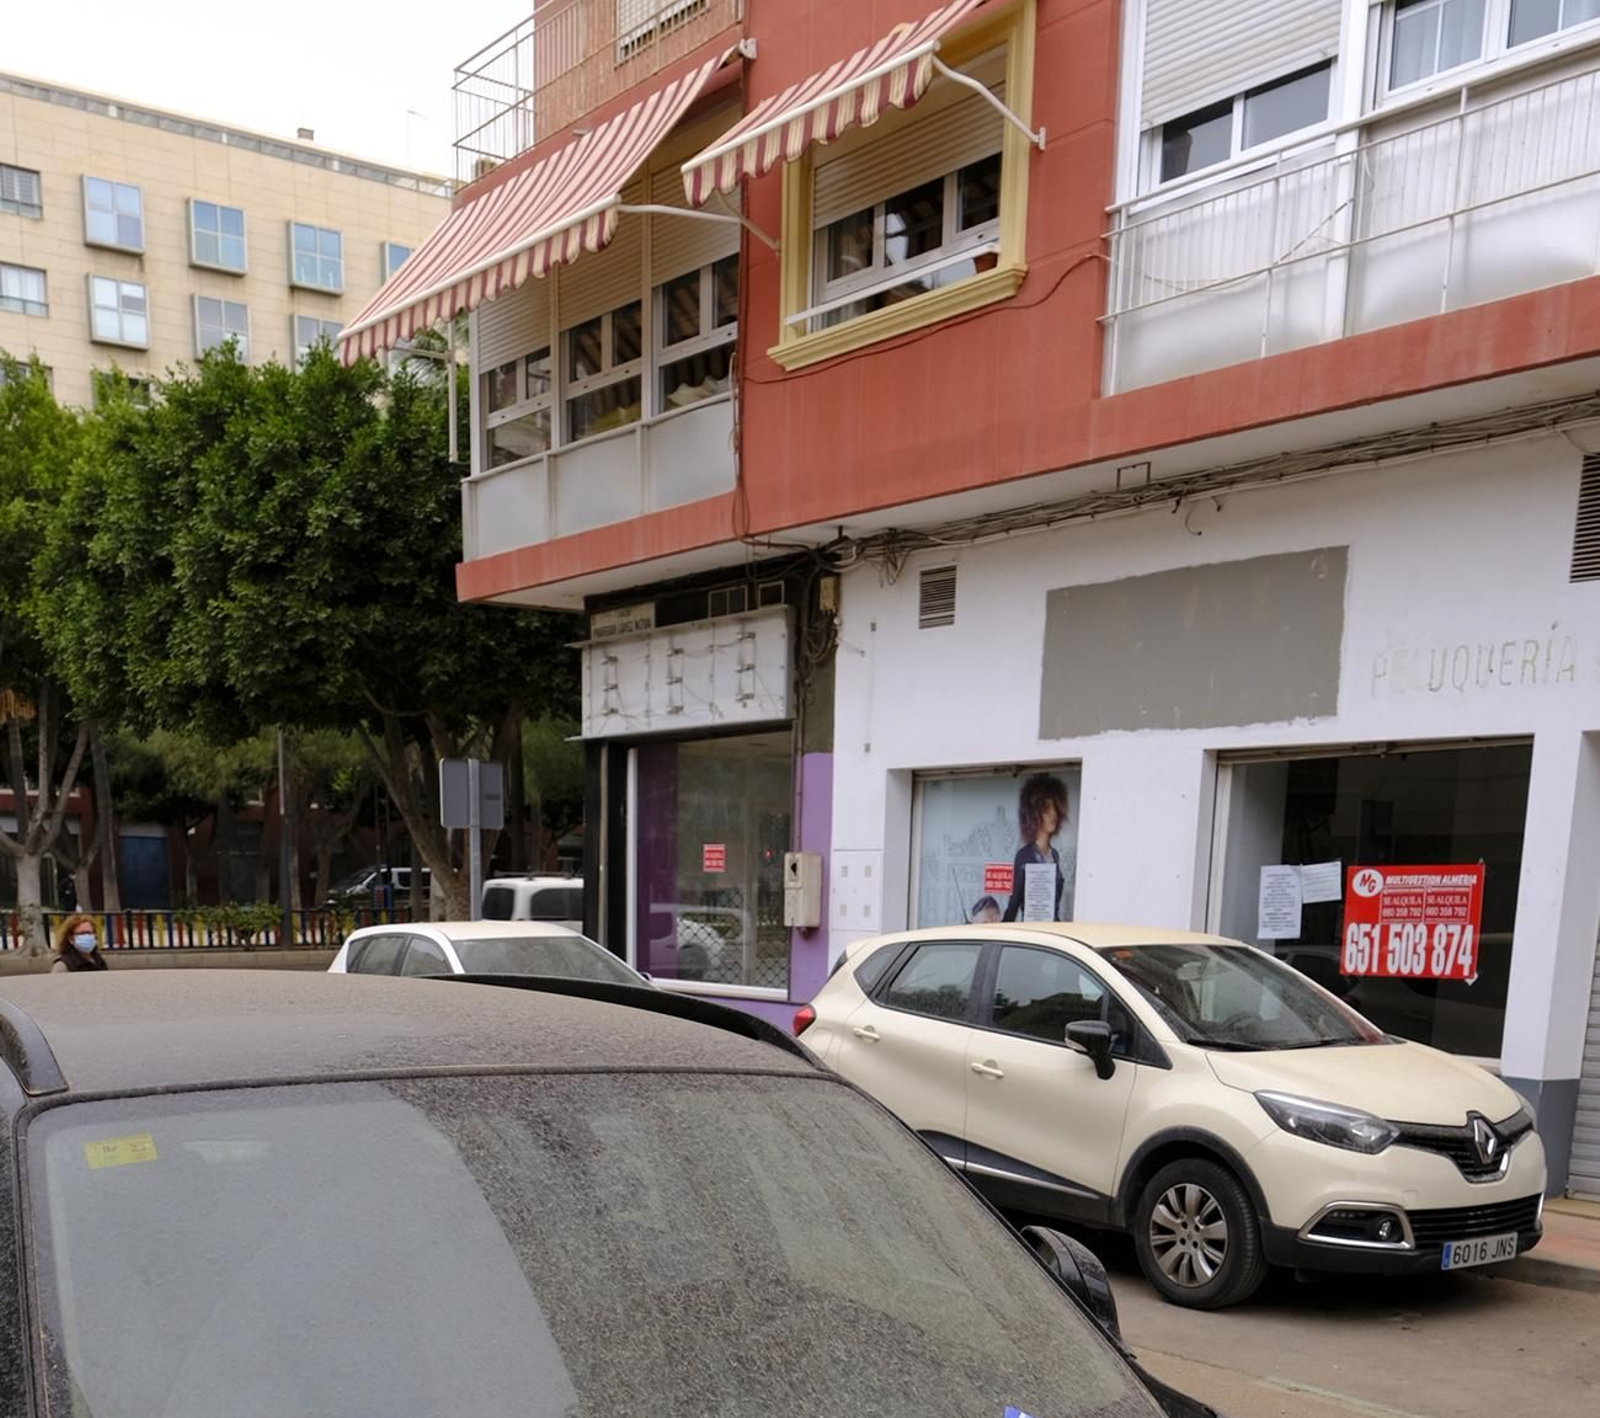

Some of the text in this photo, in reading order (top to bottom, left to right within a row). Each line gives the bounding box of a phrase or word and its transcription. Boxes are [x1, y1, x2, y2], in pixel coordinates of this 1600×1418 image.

[1392, 896, 1422, 906] ALQUILA
[1437, 895, 1467, 905] ALQUILA
[1344, 922, 1474, 977] 651 503 874
[1453, 1236, 1515, 1264] 6016 JNS
